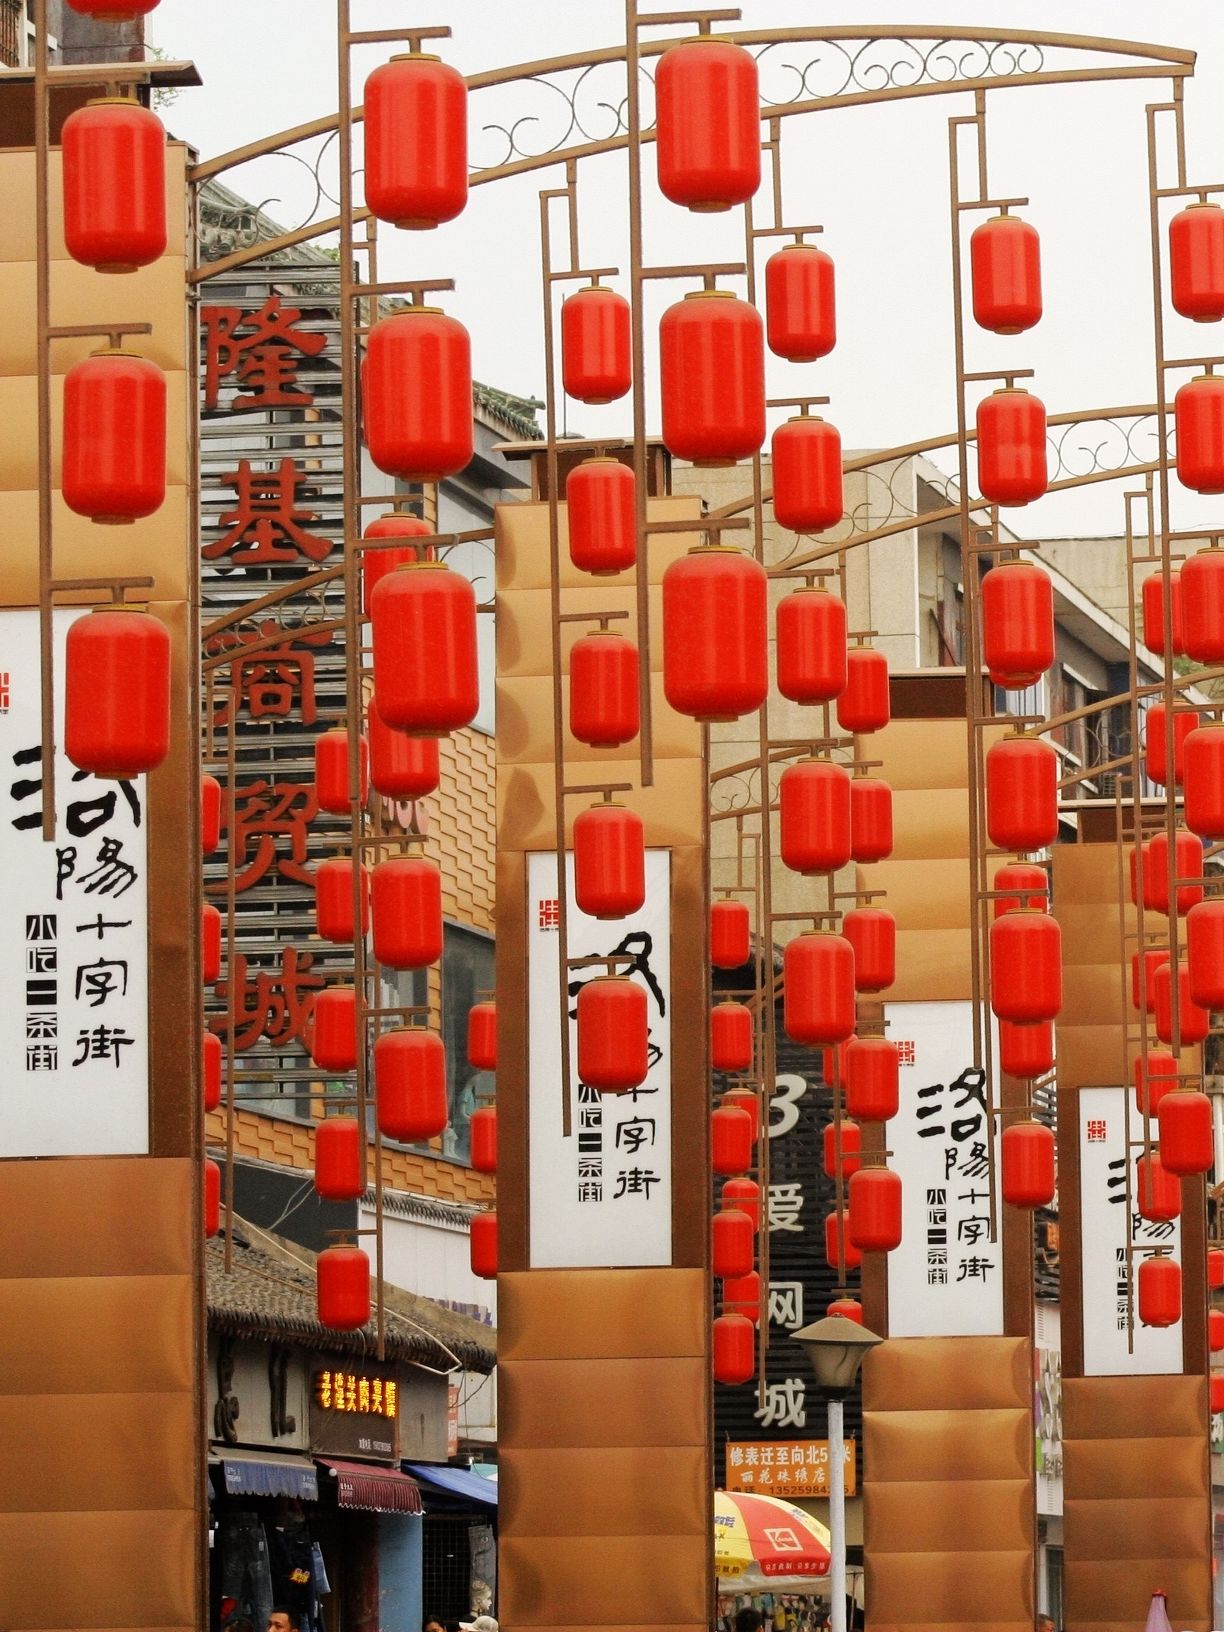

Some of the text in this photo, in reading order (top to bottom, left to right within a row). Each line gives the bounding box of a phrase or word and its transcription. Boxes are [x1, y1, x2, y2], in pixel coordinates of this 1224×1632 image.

[200, 295, 334, 1056] 隆基商贸城
[26, 914, 58, 1071] 小吃一条街
[578, 1084, 602, 1202] 小吃一条街
[927, 1189, 948, 1285] 小吃一条街
[730, 1445, 851, 1467] 修表迁至向北5米
[770, 1486, 849, 1495] 135259845
